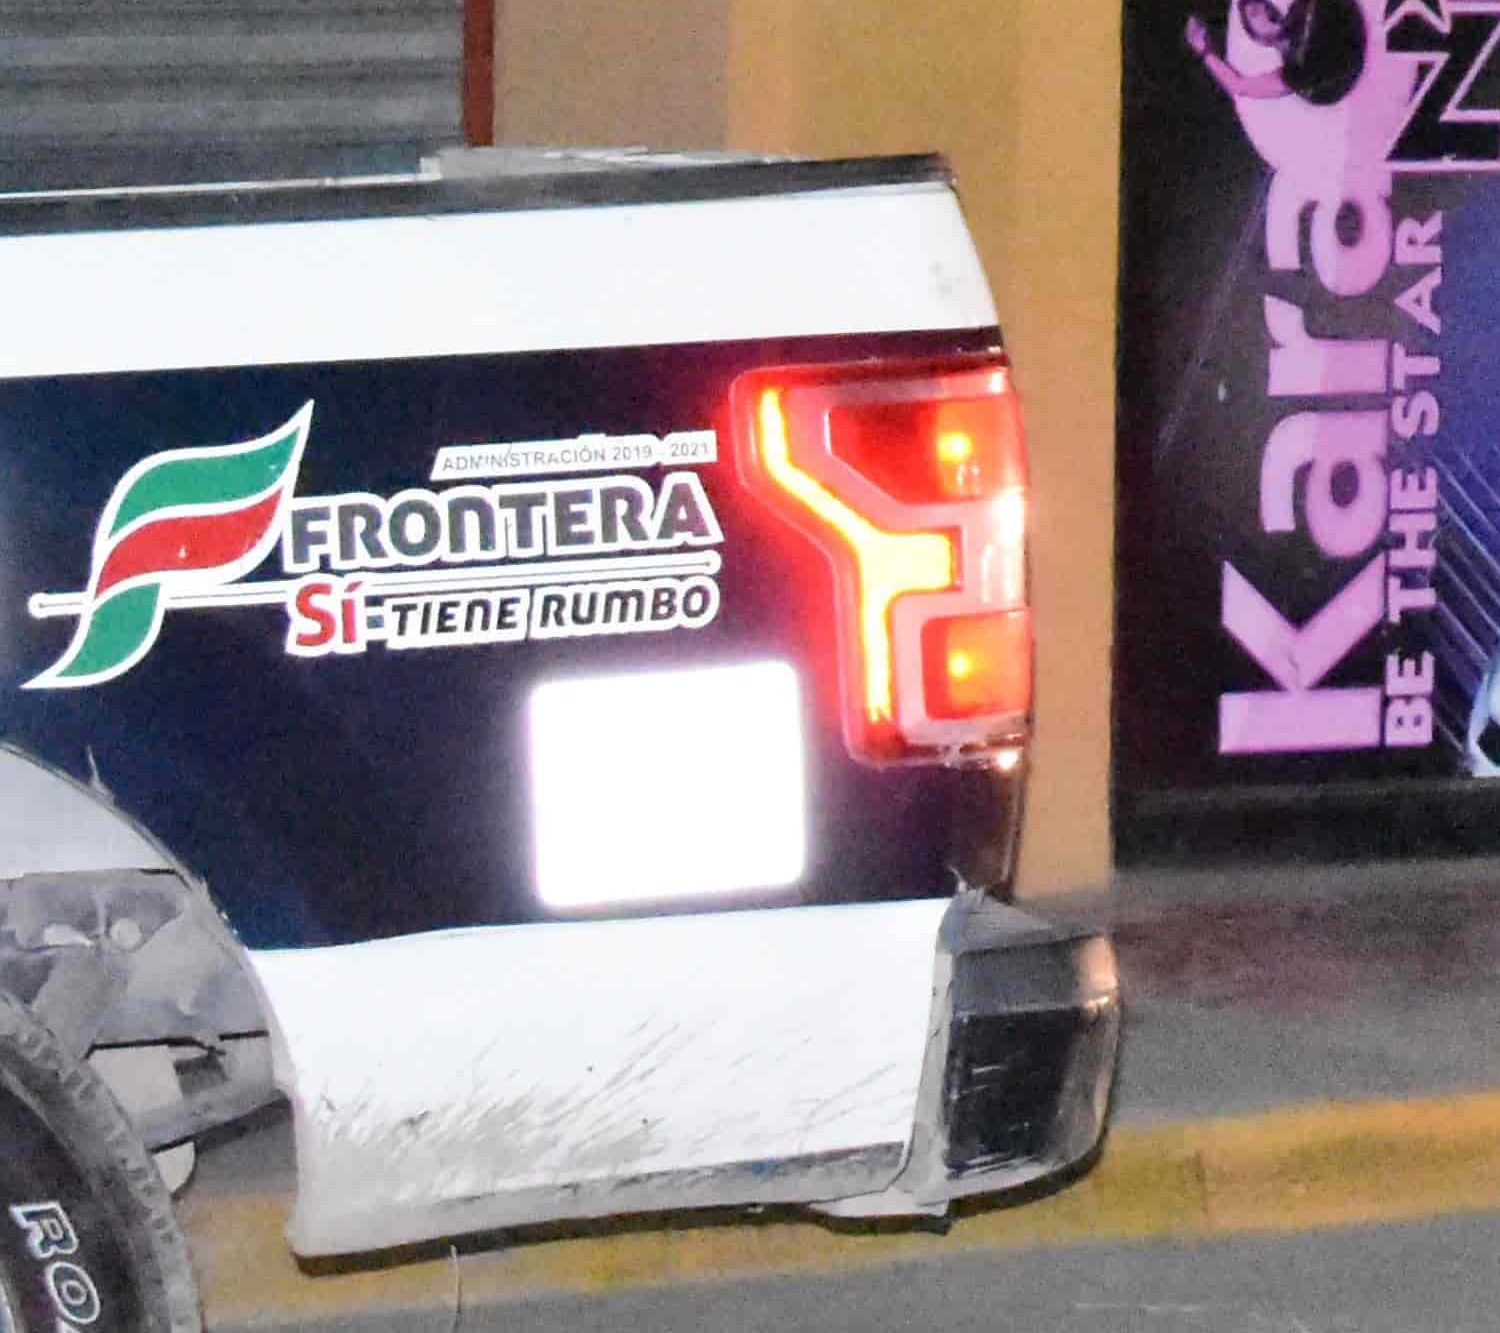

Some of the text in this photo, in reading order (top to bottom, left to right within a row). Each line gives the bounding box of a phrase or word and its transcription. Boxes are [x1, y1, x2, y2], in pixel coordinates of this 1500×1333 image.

[1387, 464, 1440, 625] THE
[1384, 649, 1437, 749] BE
[9, 1201, 101, 1333] RO
